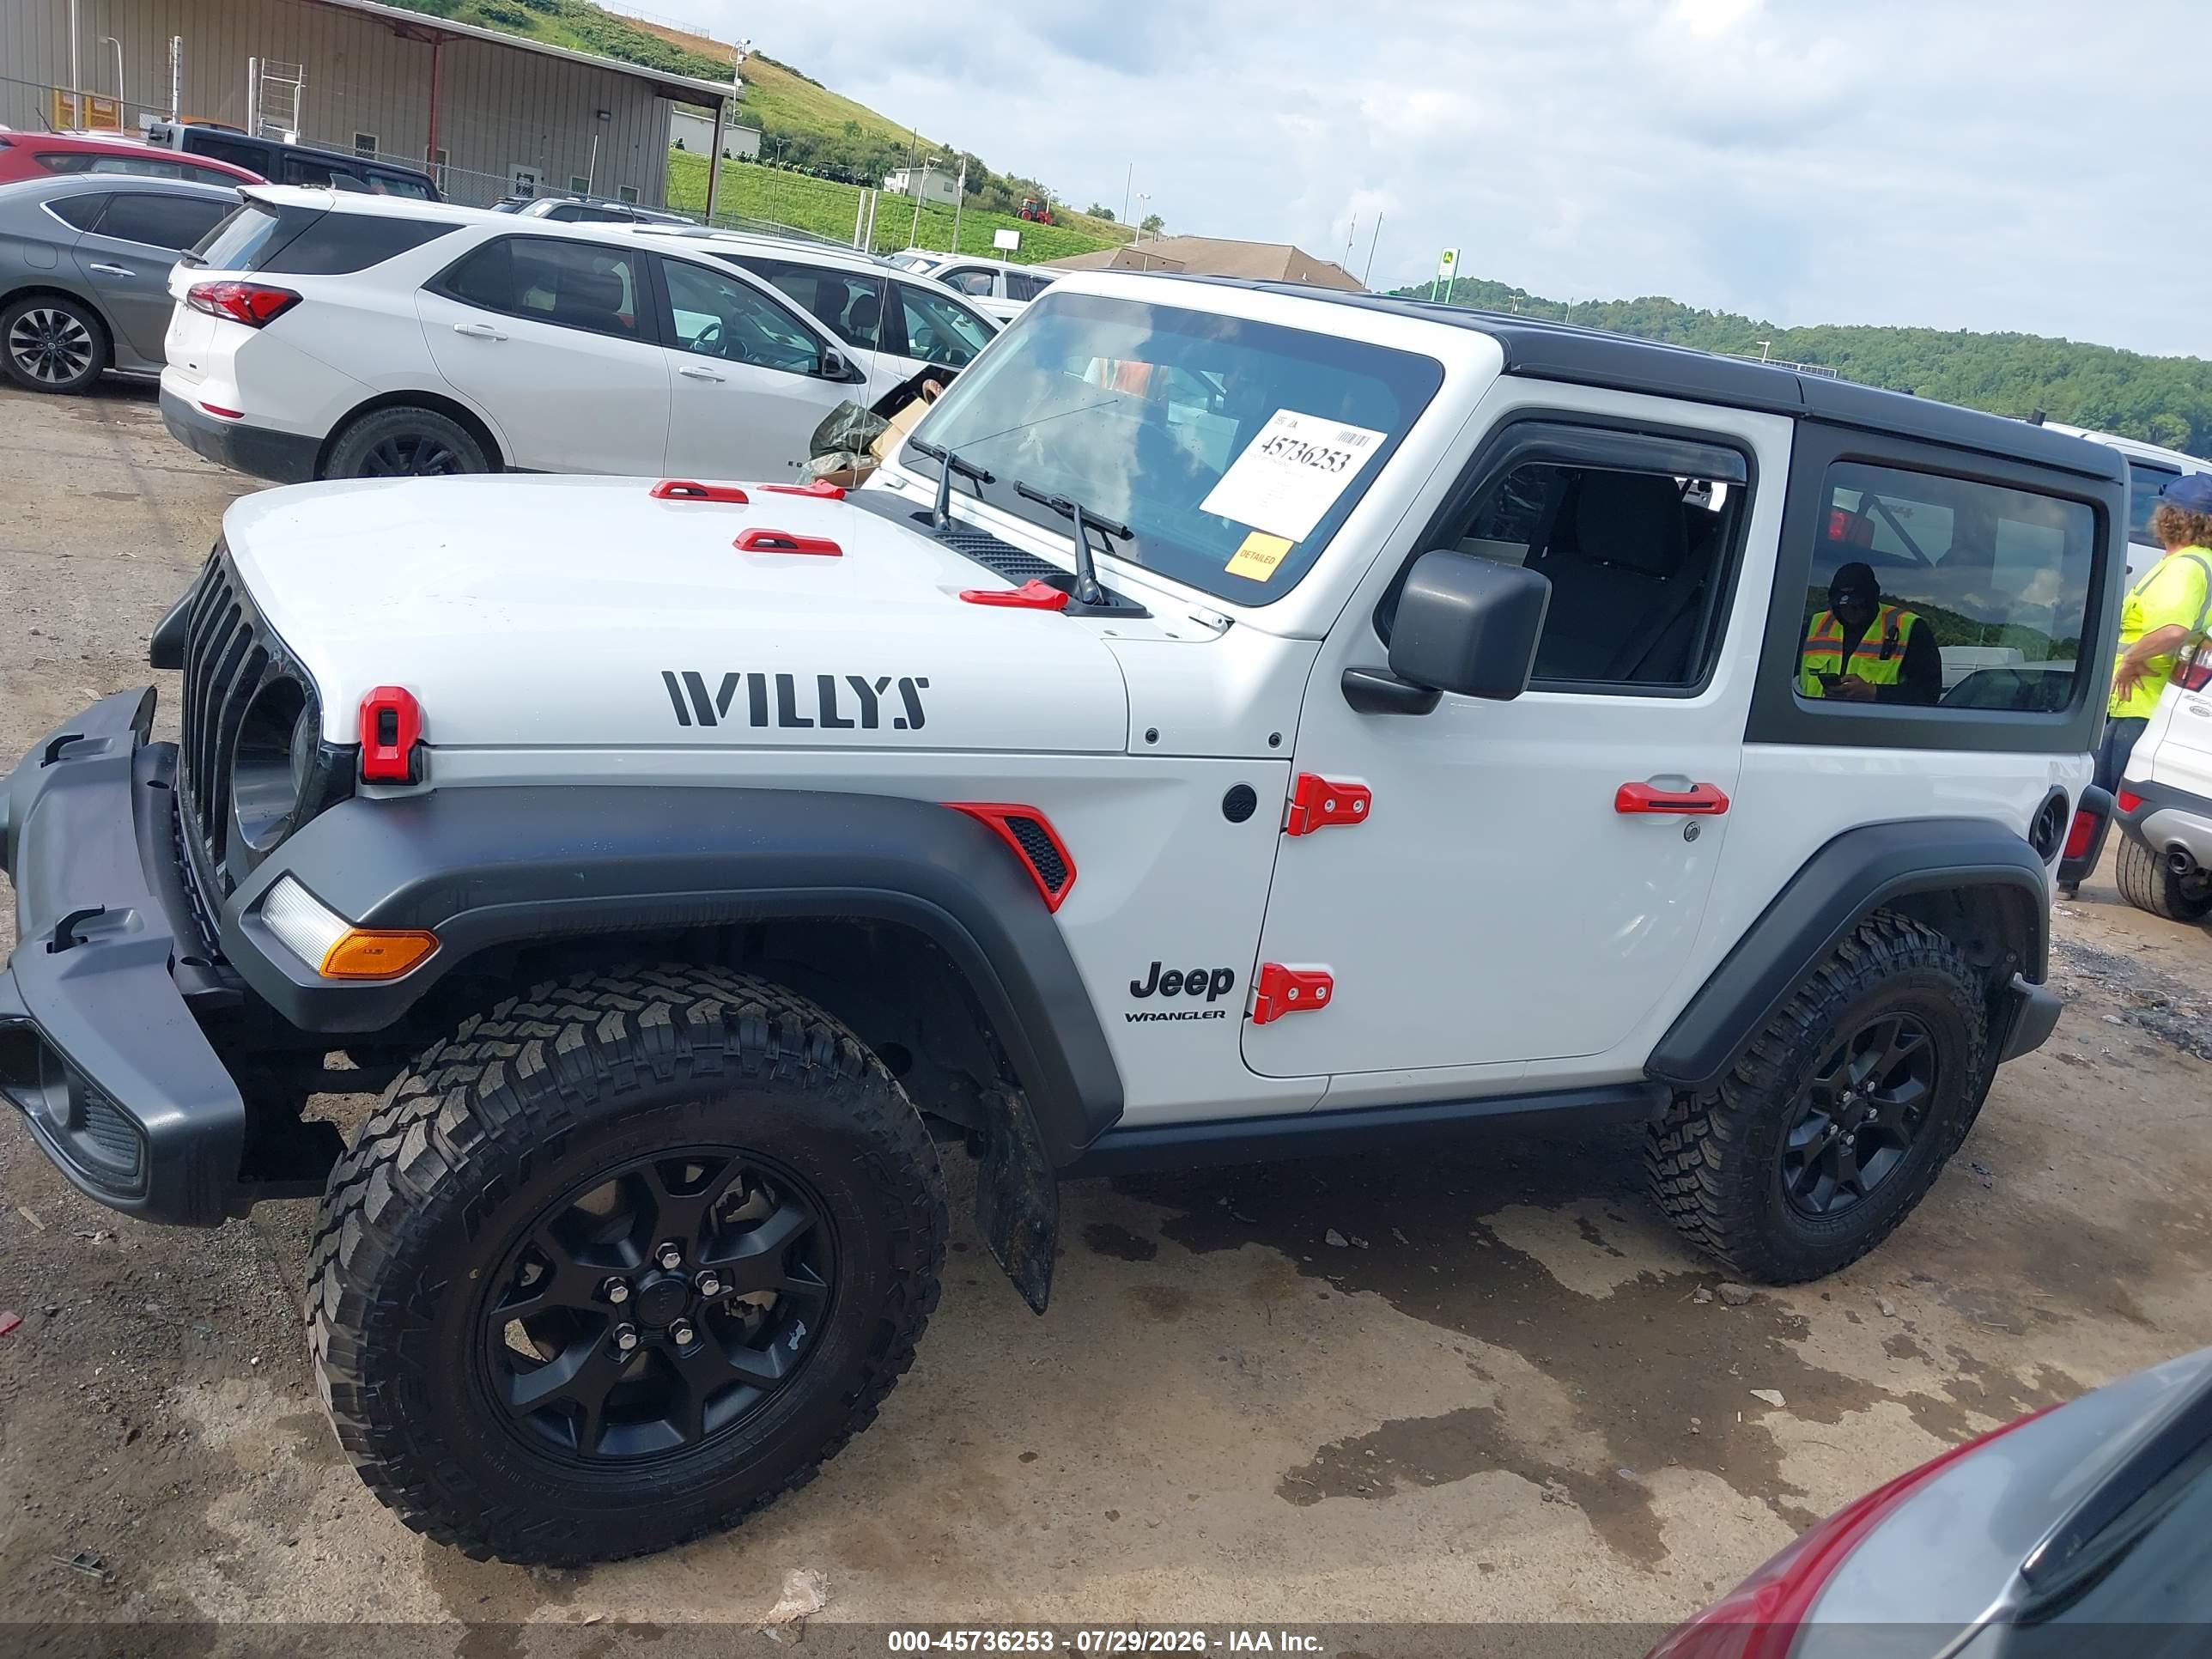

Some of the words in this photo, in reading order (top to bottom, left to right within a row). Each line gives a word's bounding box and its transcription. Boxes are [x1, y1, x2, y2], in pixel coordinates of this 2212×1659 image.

[1261, 434, 1352, 473] 45736253
[1240, 549, 1276, 565] DETAILED
[660, 671, 930, 730] WILLYS
[1129, 961, 1235, 1003] Jeep
[1124, 1010, 1226, 1023] WRANGLER
